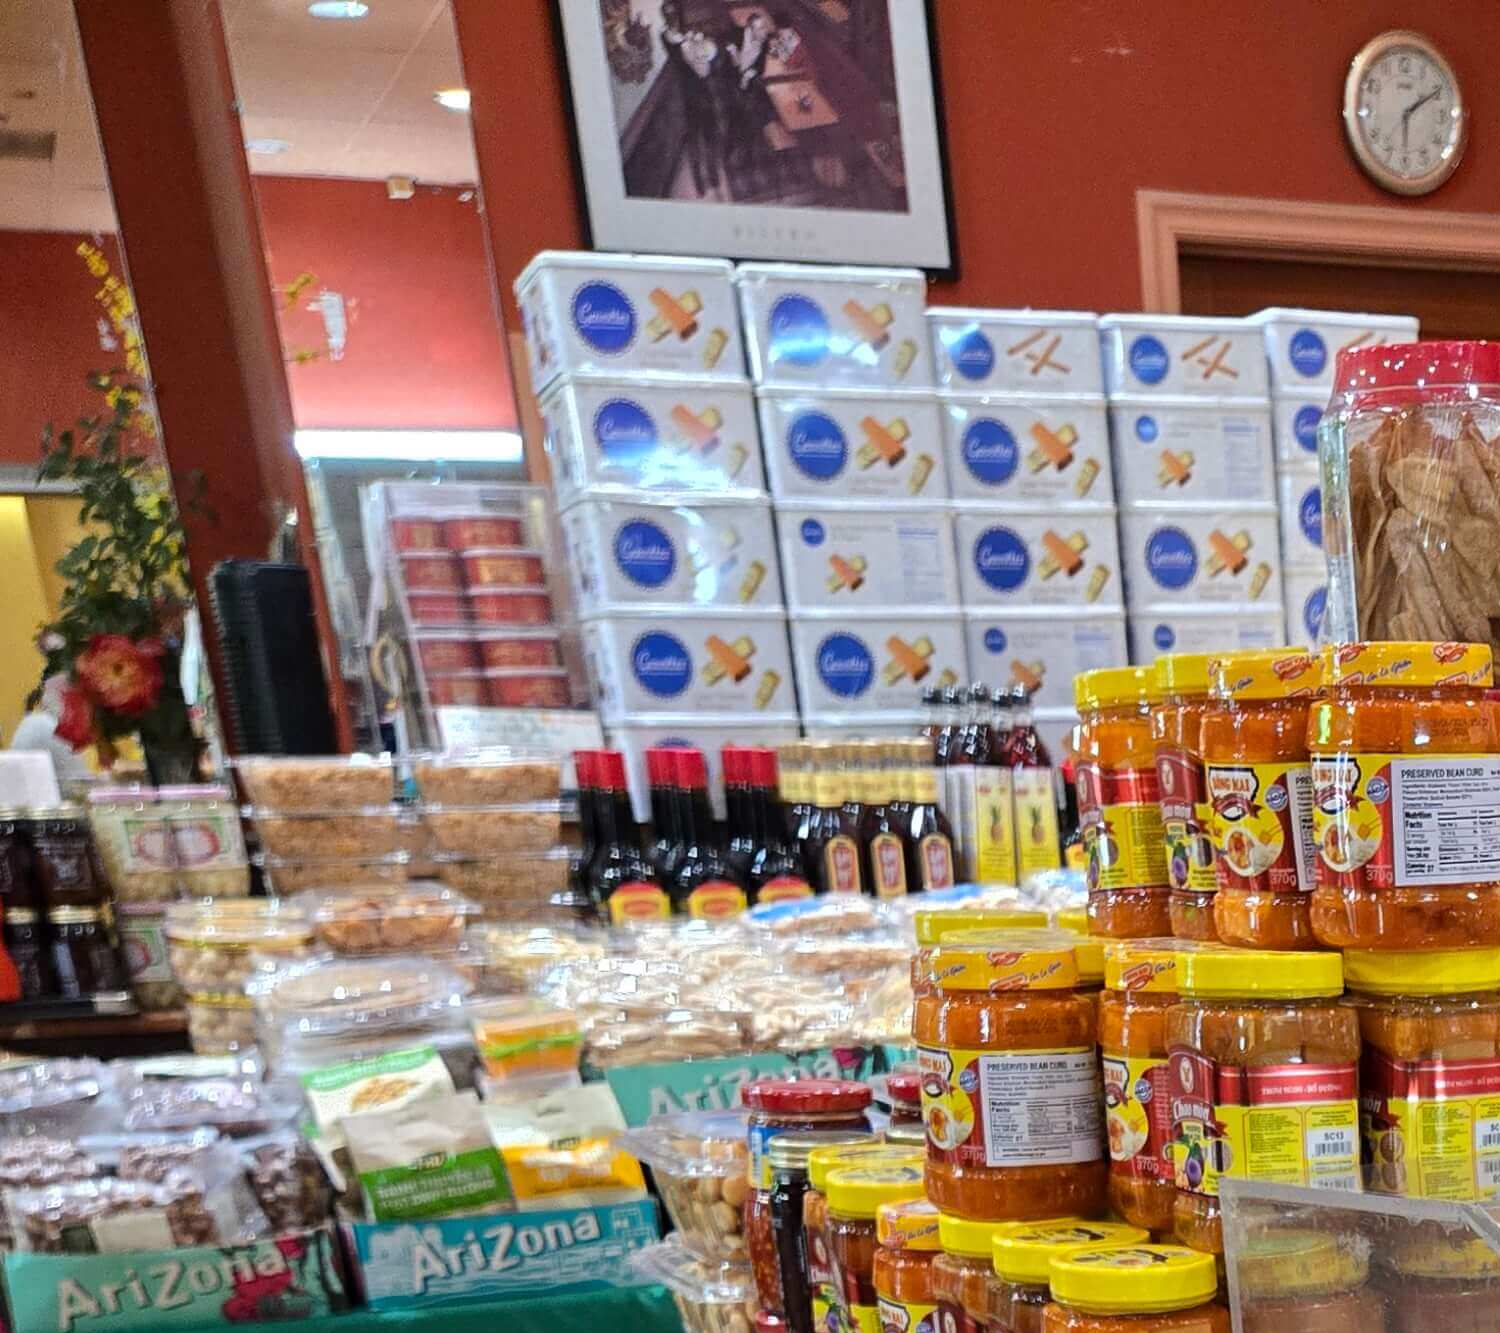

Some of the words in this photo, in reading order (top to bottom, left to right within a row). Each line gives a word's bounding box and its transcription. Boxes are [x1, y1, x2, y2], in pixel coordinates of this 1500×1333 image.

[1400, 768, 1445, 779] PRESERVED
[1446, 768, 1466, 779] BEAN
[1323, 1130, 1345, 1142] SC13
[410, 1210, 600, 1295] AriZona
